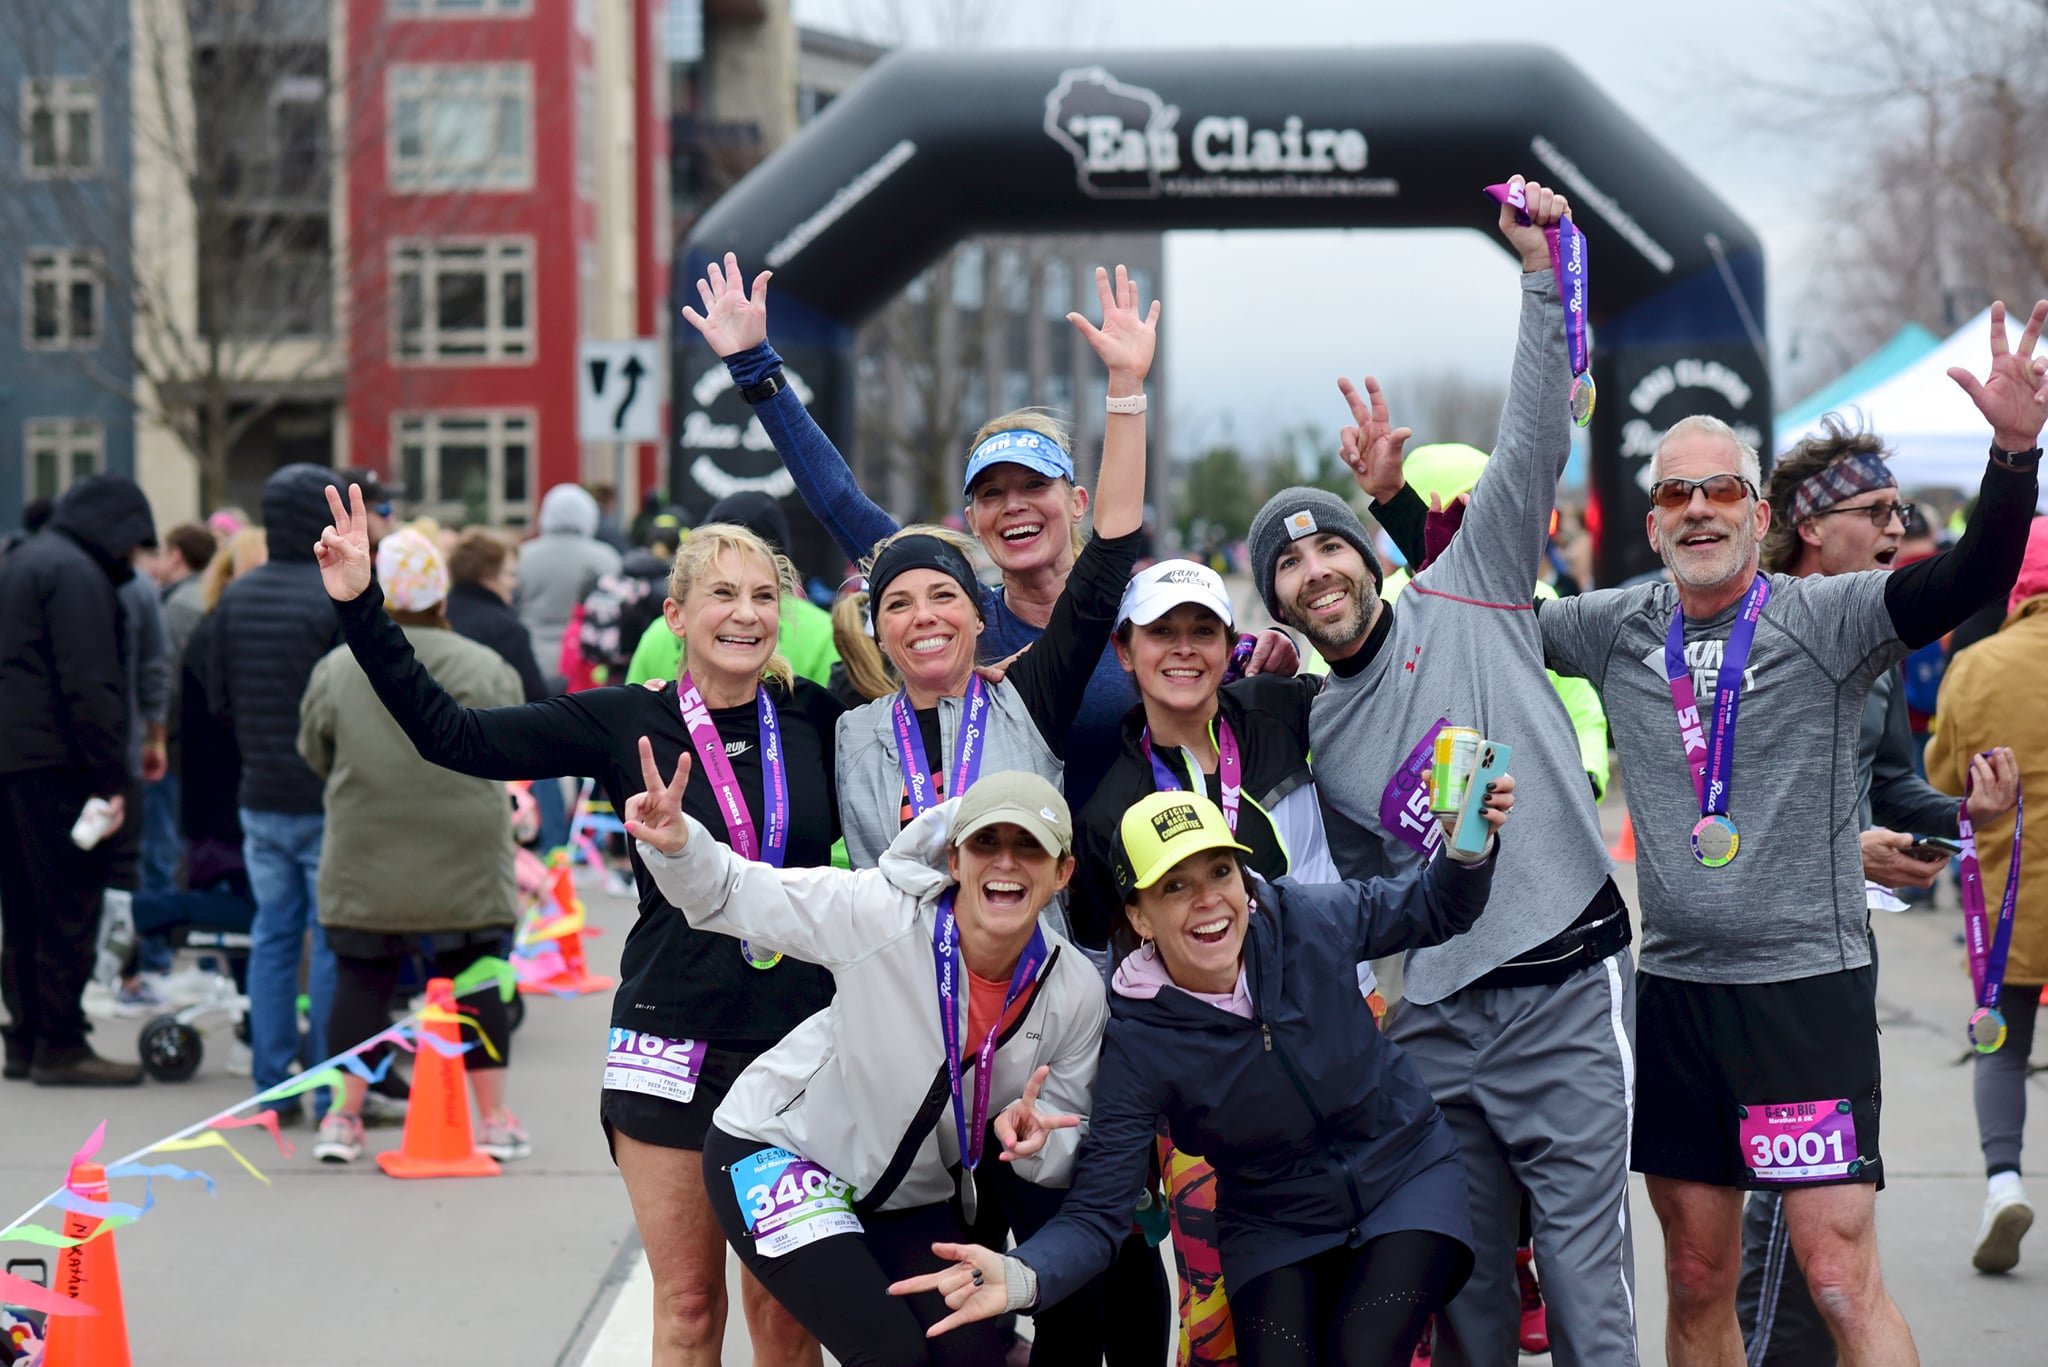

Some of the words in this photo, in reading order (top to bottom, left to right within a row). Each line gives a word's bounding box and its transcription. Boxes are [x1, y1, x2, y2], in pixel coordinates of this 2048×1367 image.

[1087, 114, 1180, 172] Eau
[1192, 115, 1369, 172] Claire
[1567, 231, 1583, 276] Series
[1570, 277, 1582, 314] Race
[1171, 569, 1200, 579] RUN
[1172, 577, 1213, 590] WEST
[679, 687, 713, 735] 5K
[970, 695, 984, 721] Race
[1720, 688, 1728, 706] EAU
[1676, 705, 1708, 756] 5K
[1716, 706, 1727, 737] CLAIRE
[725, 741, 747, 752] RUN
[767, 731, 778, 763] Race
[962, 723, 980, 763] Series
[1710, 737, 1723, 781] MARATHON
[910, 772, 925, 802] Race
[1708, 779, 1723, 813] Race
[722, 785, 743, 826] SCHEELS
[775, 801, 784, 830] CLAIRE
[1153, 804, 1194, 826] OFFICIAL
[1167, 815, 1188, 827] RACE
[1222, 784, 1241, 832] 5K
[1161, 819, 1201, 840] COMMITTEE
[1959, 819, 1977, 862] 5K
[938, 913, 955, 958] Series
[940, 961, 952, 999] Race
[1797, 1103, 1816, 1116] BIG
[1750, 1130, 1844, 1167] 3001
